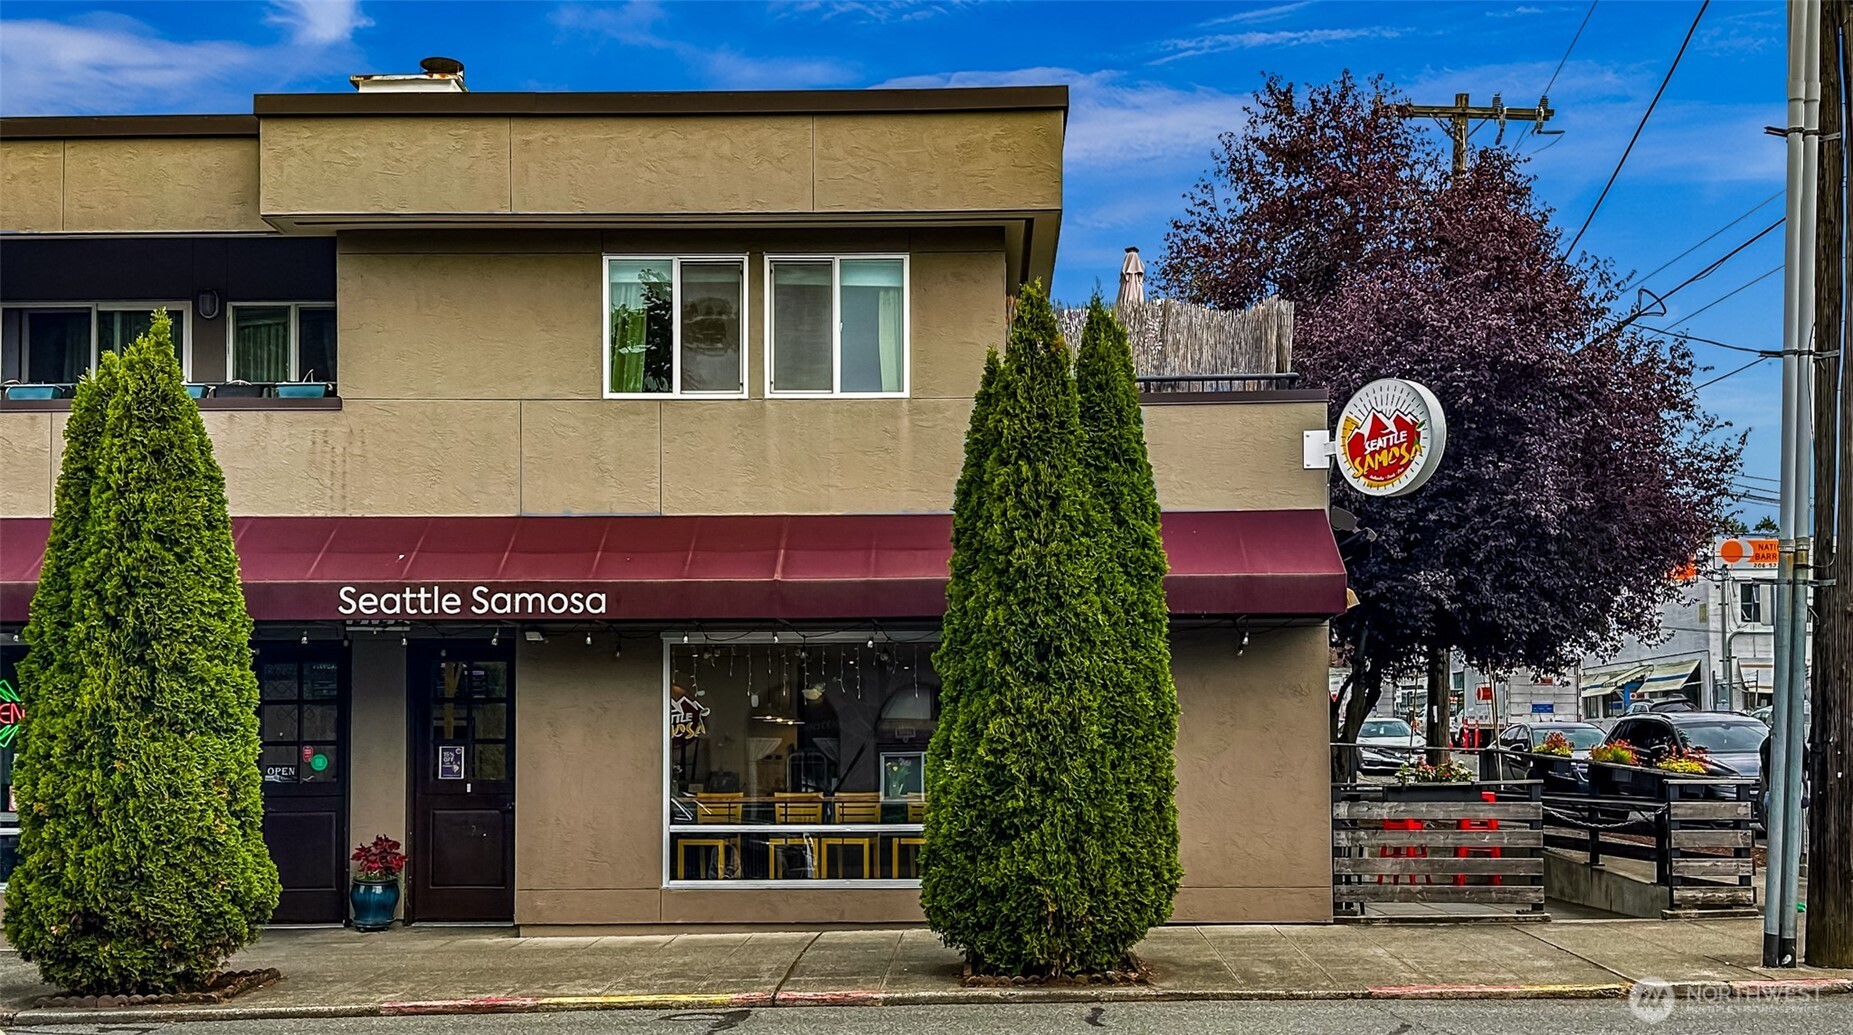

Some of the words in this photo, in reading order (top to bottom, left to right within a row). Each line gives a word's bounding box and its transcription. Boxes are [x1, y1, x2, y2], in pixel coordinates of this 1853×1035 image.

[1364, 430, 1408, 455] SEATTLE
[1353, 442, 1423, 478] SAMOSA
[1754, 552, 1778, 561] BARR
[1758, 543, 1779, 551] NATI
[337, 585, 462, 615] Seattle
[470, 585, 607, 615] Samosa
[0, 702, 26, 724] EN
[671, 721, 706, 740] OSA
[267, 766, 296, 776] OPEN
